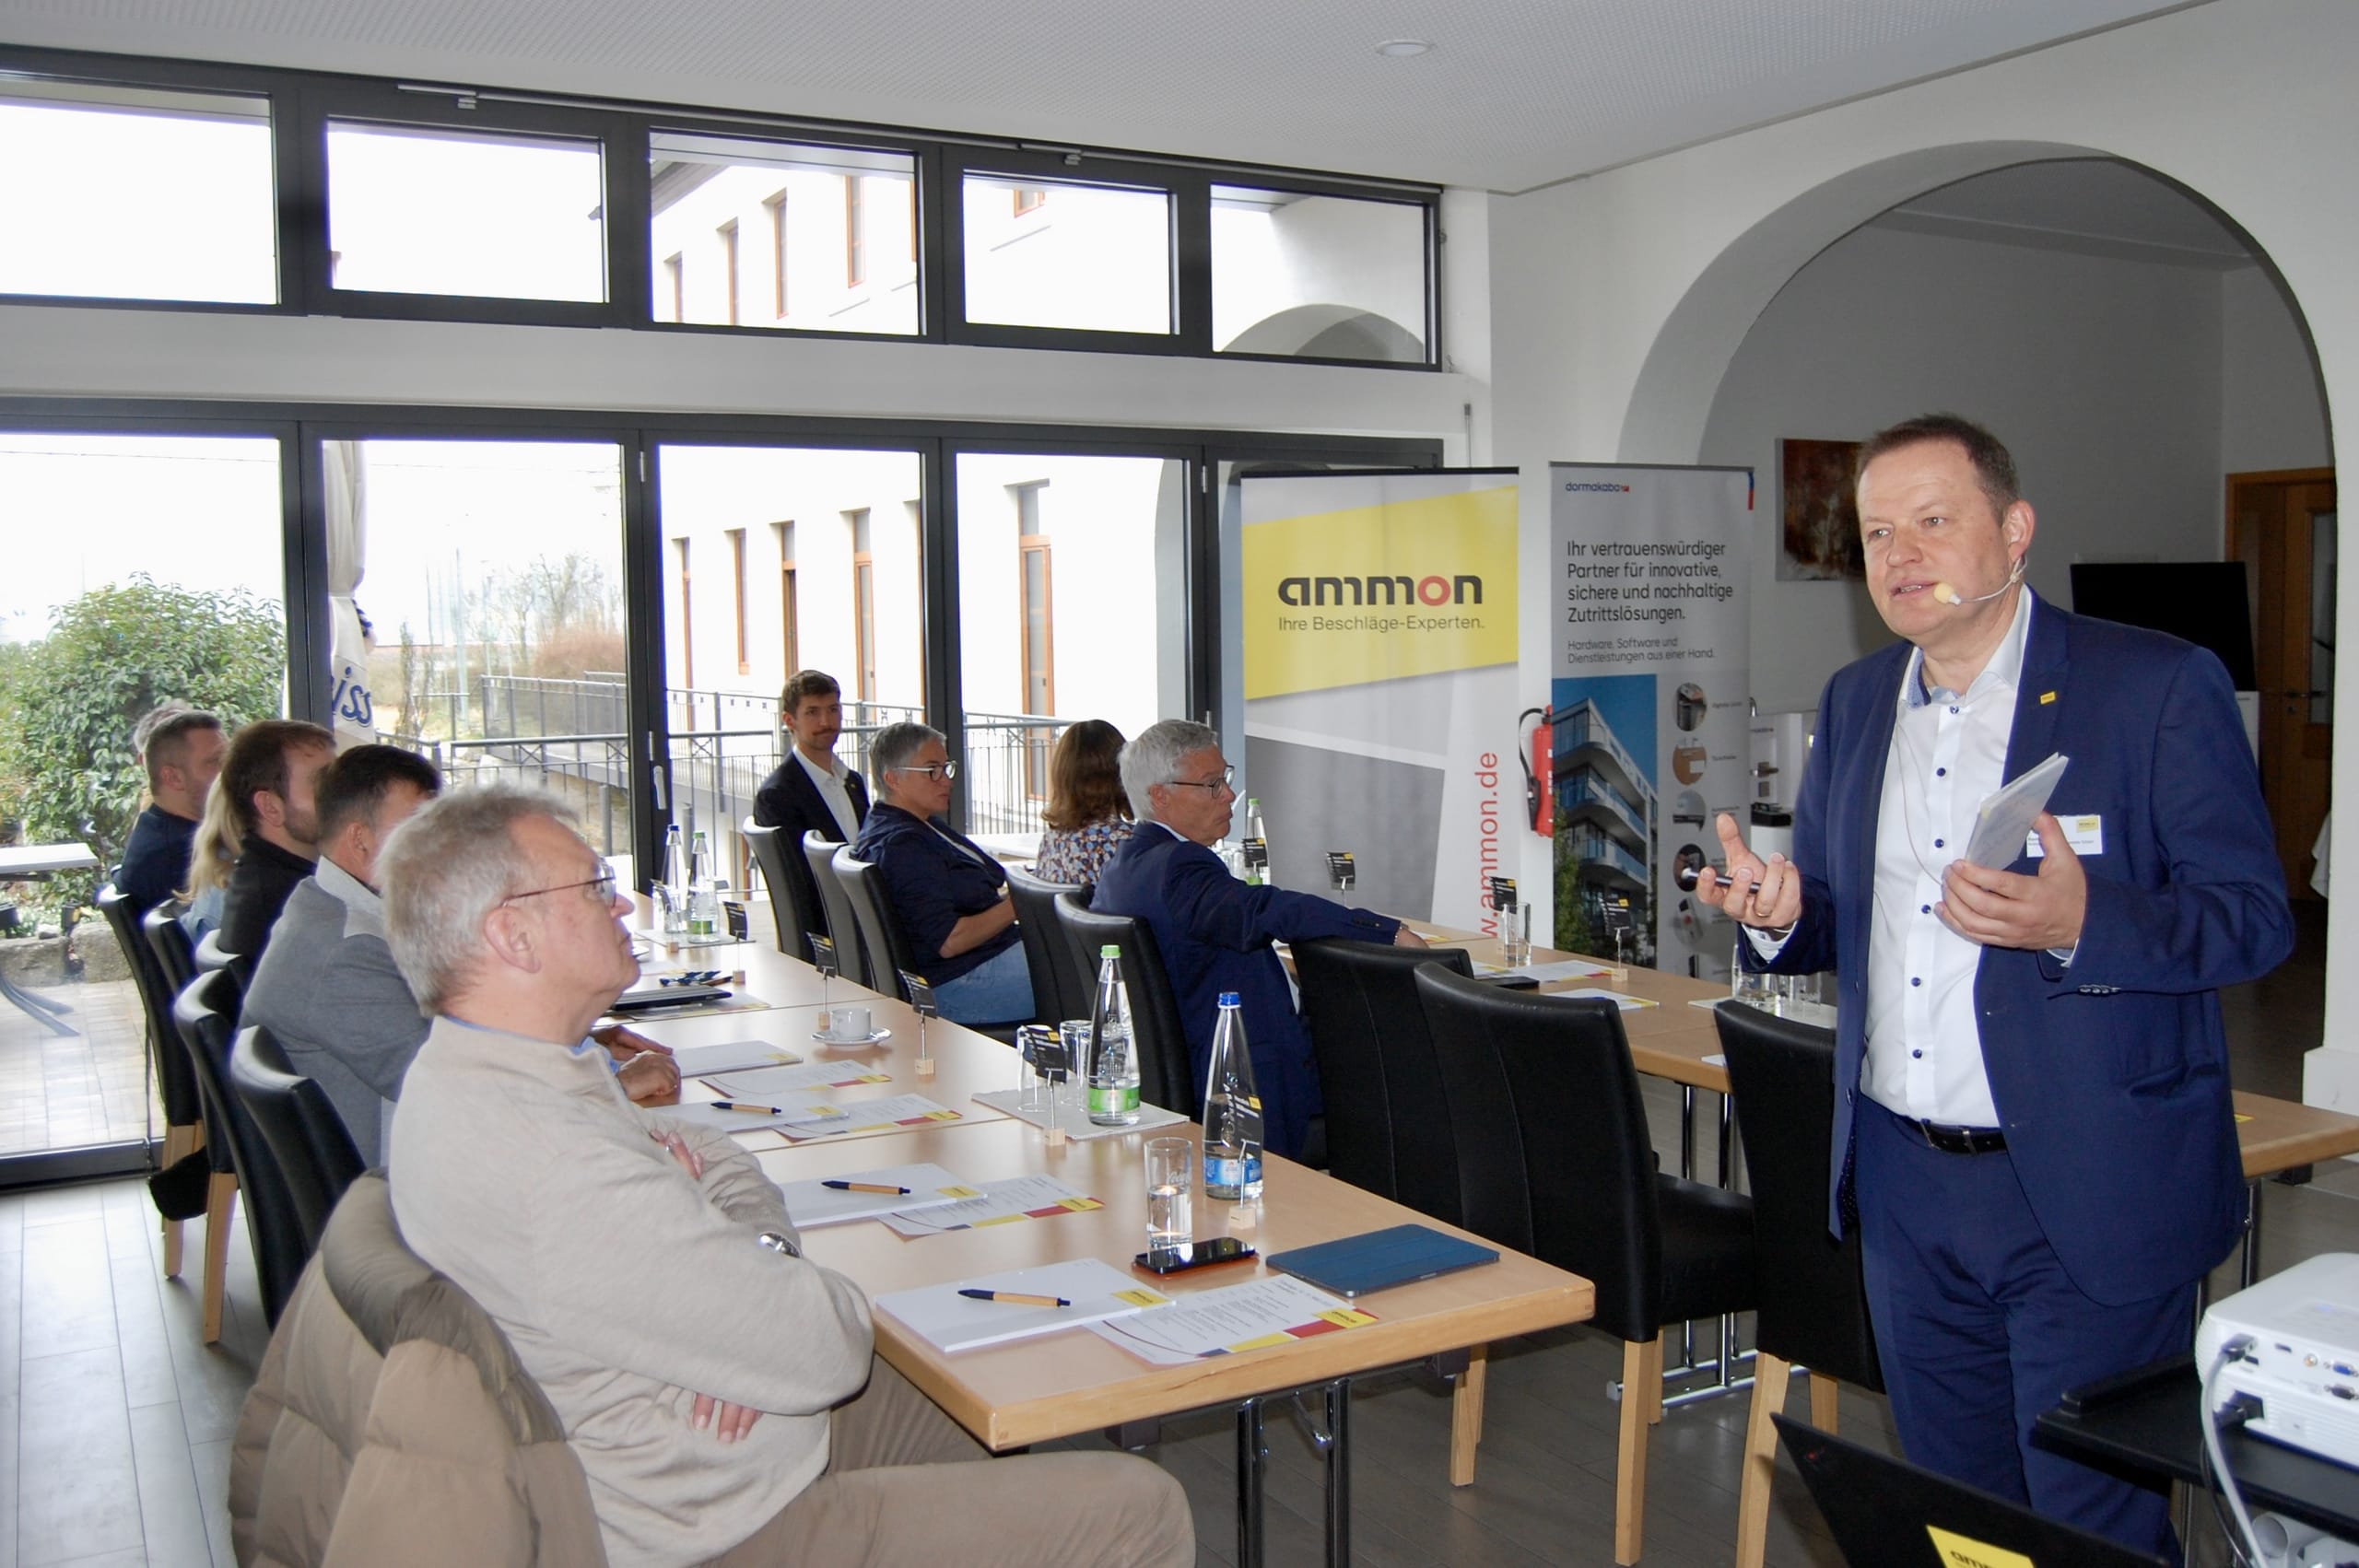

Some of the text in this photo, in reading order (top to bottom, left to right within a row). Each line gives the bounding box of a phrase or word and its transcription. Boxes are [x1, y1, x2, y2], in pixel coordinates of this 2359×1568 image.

[1566, 481, 1621, 492] dormakaba
[1567, 541, 1725, 559] Ihr vertrauenswürdiger
[1567, 562, 1721, 579] Partner für innovative,
[1277, 575, 1483, 606] ammon
[1567, 583, 1733, 602] sichere und nachhaltige
[1279, 615, 1485, 633] Ihre Beschläge-Experten.
[1567, 606, 1685, 624] Zutrittslösungen.
[1616, 638, 1660, 649] Software
[1661, 638, 1678, 647] und
[1567, 649, 1716, 663] Dienstleistungen aus einer Hand.
